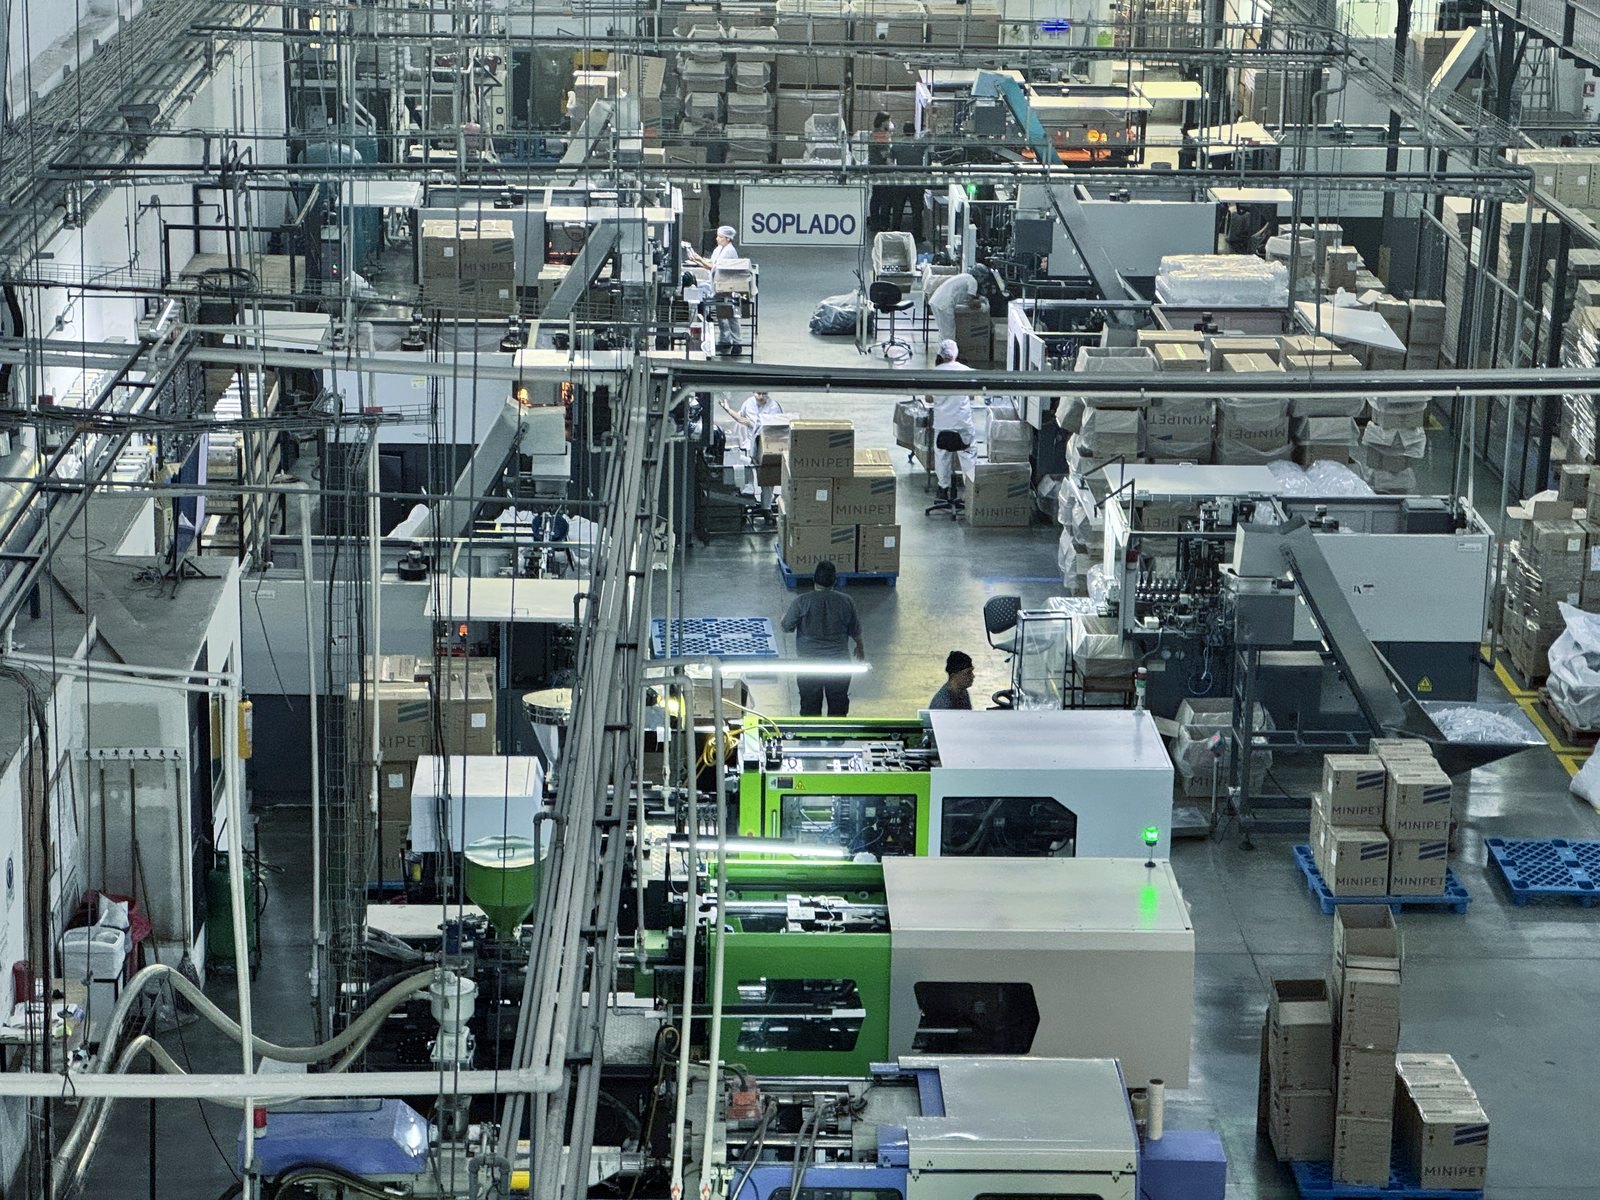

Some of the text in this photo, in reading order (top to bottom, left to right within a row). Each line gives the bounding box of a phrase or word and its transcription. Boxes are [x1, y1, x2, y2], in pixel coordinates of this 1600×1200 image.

[751, 212, 856, 235] SOPLADO
[1150, 415, 1210, 425] MINIPET
[793, 458, 851, 468] MINIPET
[836, 504, 894, 515] MINIPET
[975, 506, 1028, 517] MINIPET
[796, 553, 852, 565] MINIPET
[1332, 805, 1383, 816] MINIPET
[1397, 821, 1449, 831] MINIPET
[1336, 877, 1385, 887] MINIPET
[1393, 877, 1444, 887] MINIPET
[1424, 1166, 1485, 1178] MINIPET
